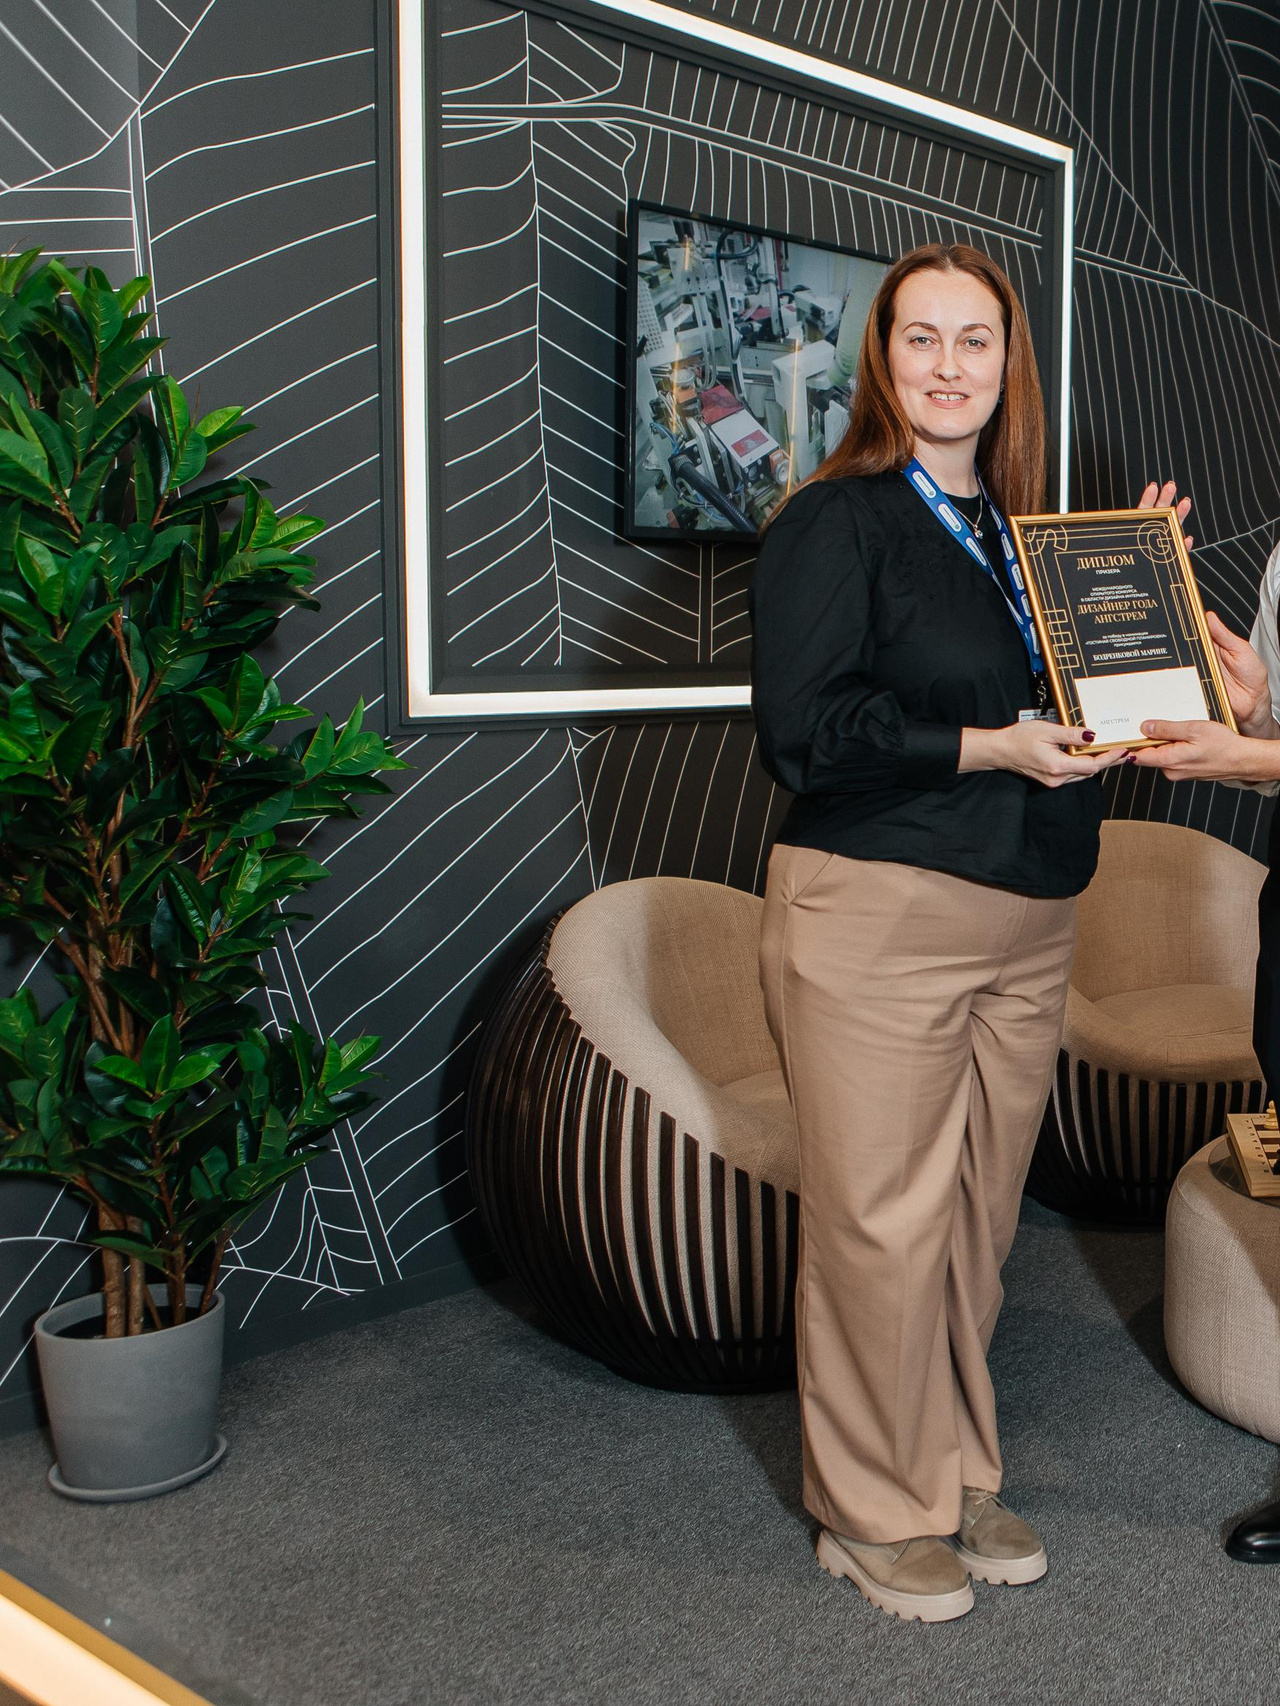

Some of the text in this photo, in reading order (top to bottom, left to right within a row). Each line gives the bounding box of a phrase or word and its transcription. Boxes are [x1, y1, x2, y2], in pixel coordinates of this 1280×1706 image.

[1076, 554, 1135, 571] ДИПЛОМ
[1077, 599, 1158, 615] ДИЗАЙНЕР ГОДА
[1094, 611, 1147, 624] АНГСТРЕМ
[1141, 648, 1168, 656] МАРИНЕ
